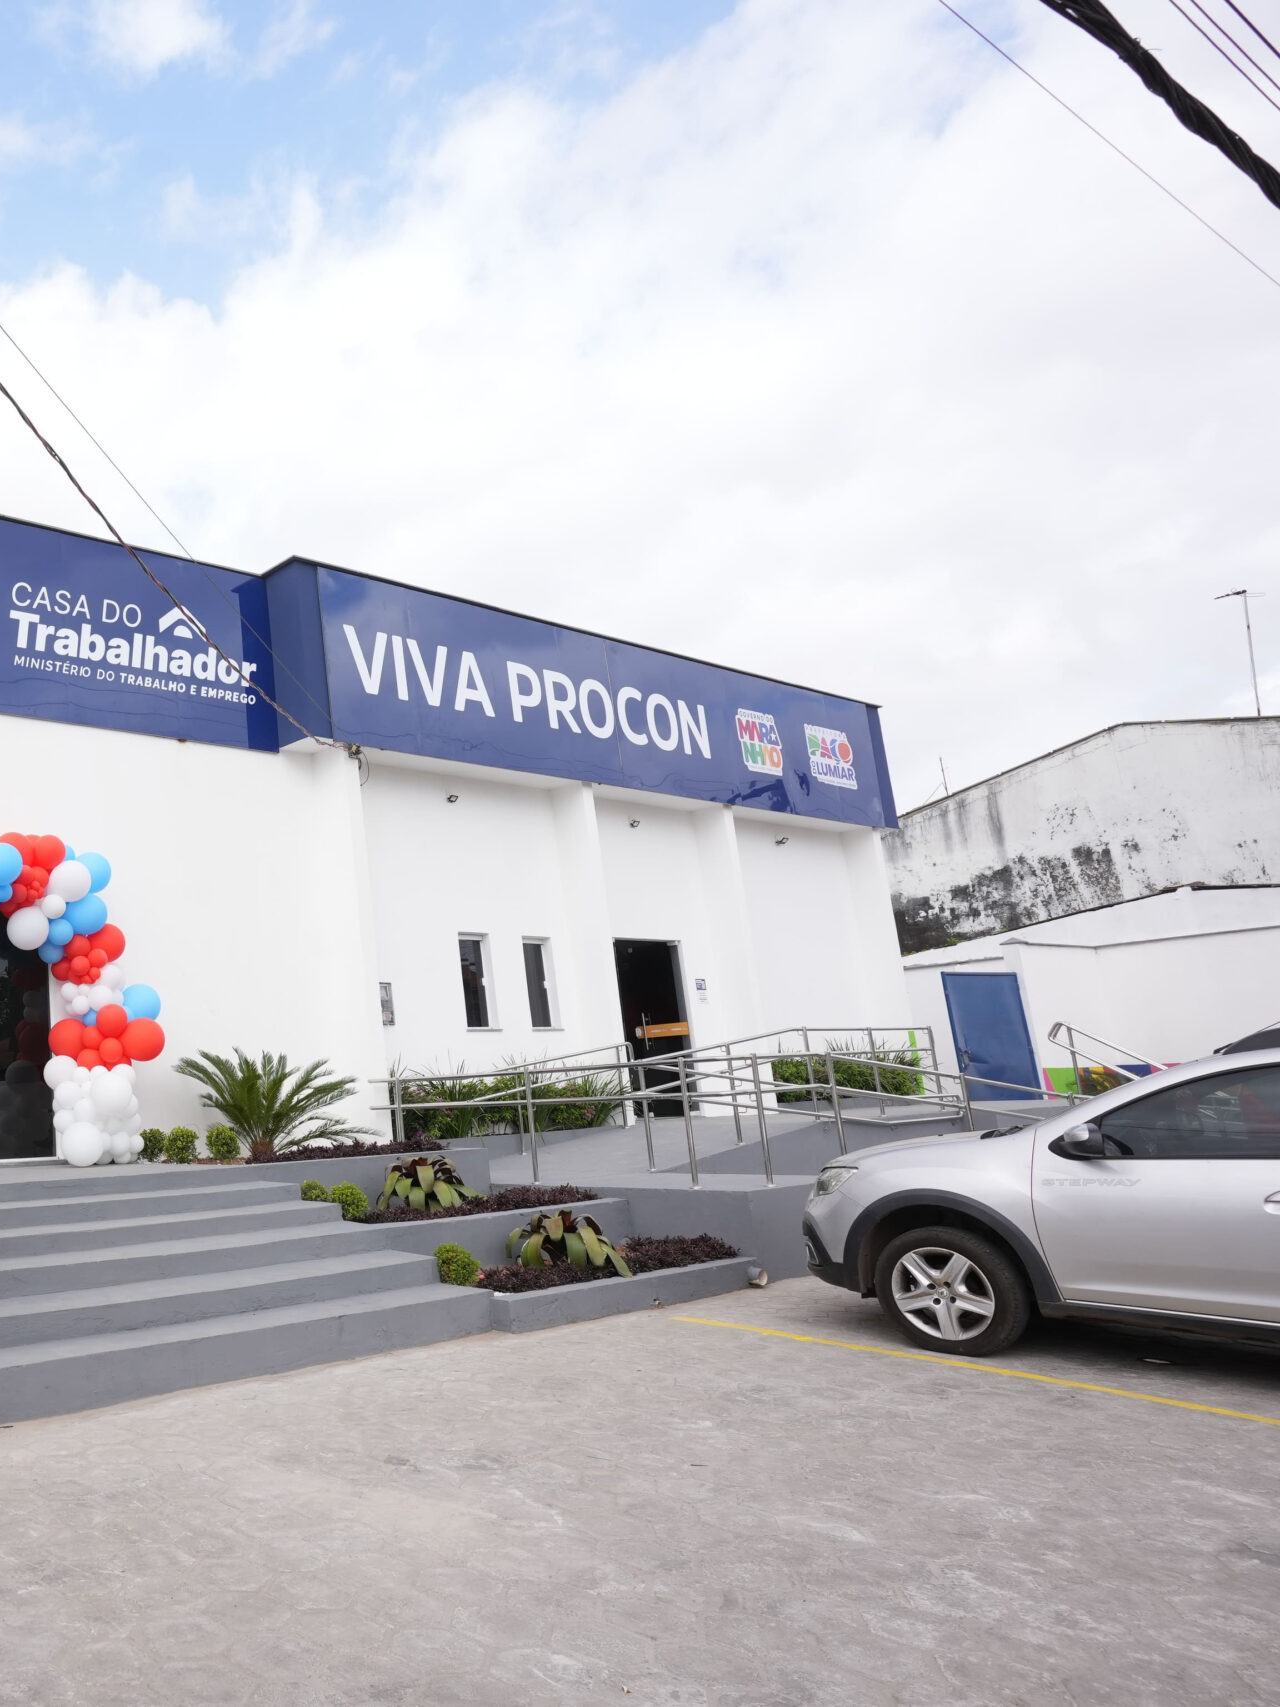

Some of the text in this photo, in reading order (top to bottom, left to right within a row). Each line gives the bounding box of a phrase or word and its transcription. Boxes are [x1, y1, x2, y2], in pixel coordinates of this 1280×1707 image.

[12, 582, 142, 628] CASA DO
[10, 610, 257, 688] Trabalhador
[14, 654, 256, 705] MINISTÉRIO DO TRABALHO E EMPREGO
[342, 624, 712, 759] VIVA PROCON
[807, 734, 852, 765] PAÇO
[1041, 1178, 1142, 1187] STEPWAY
